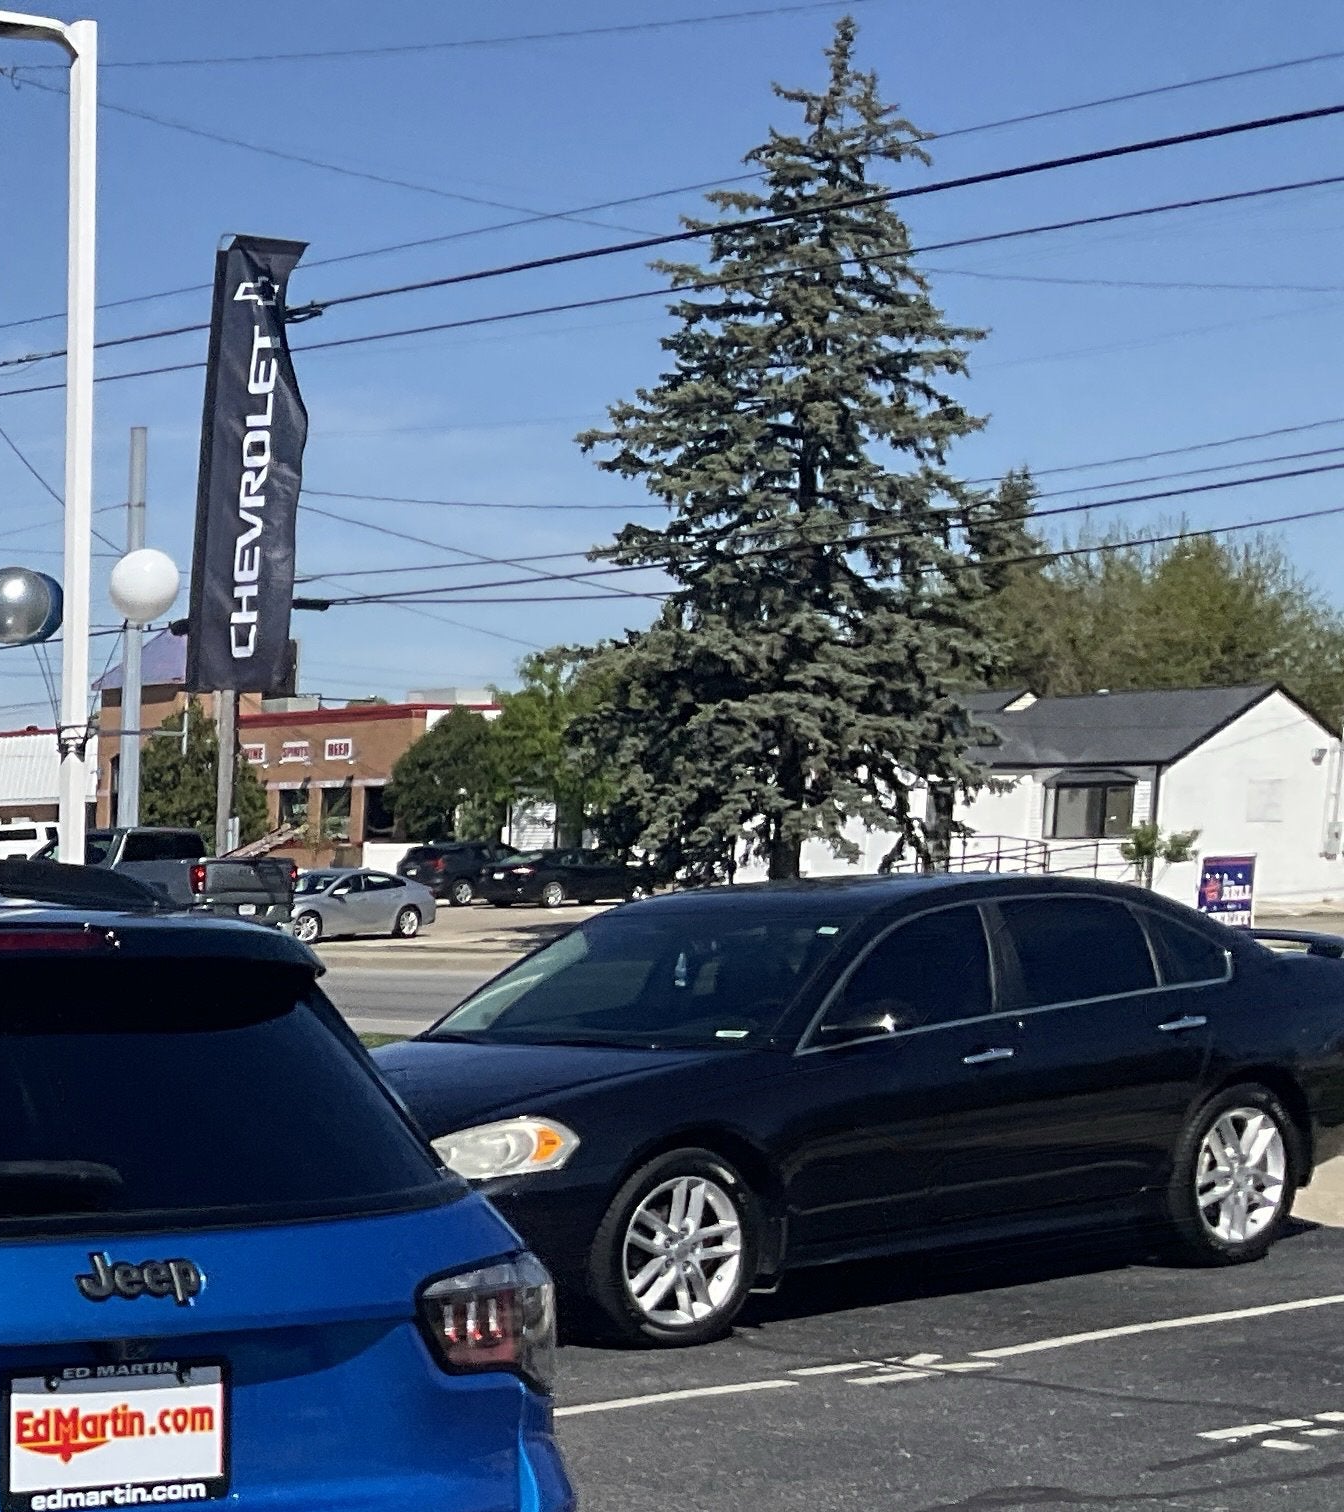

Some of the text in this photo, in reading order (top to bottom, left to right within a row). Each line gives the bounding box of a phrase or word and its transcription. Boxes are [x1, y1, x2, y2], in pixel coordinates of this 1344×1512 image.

[230, 325, 280, 659] CHEVROLET
[75, 1252, 207, 1307] Jeep
[63, 1361, 178, 1380] ED MARTIN
[15, 1404, 214, 1449] EdMartin.com
[30, 1482, 206, 1511] edmartin.com
